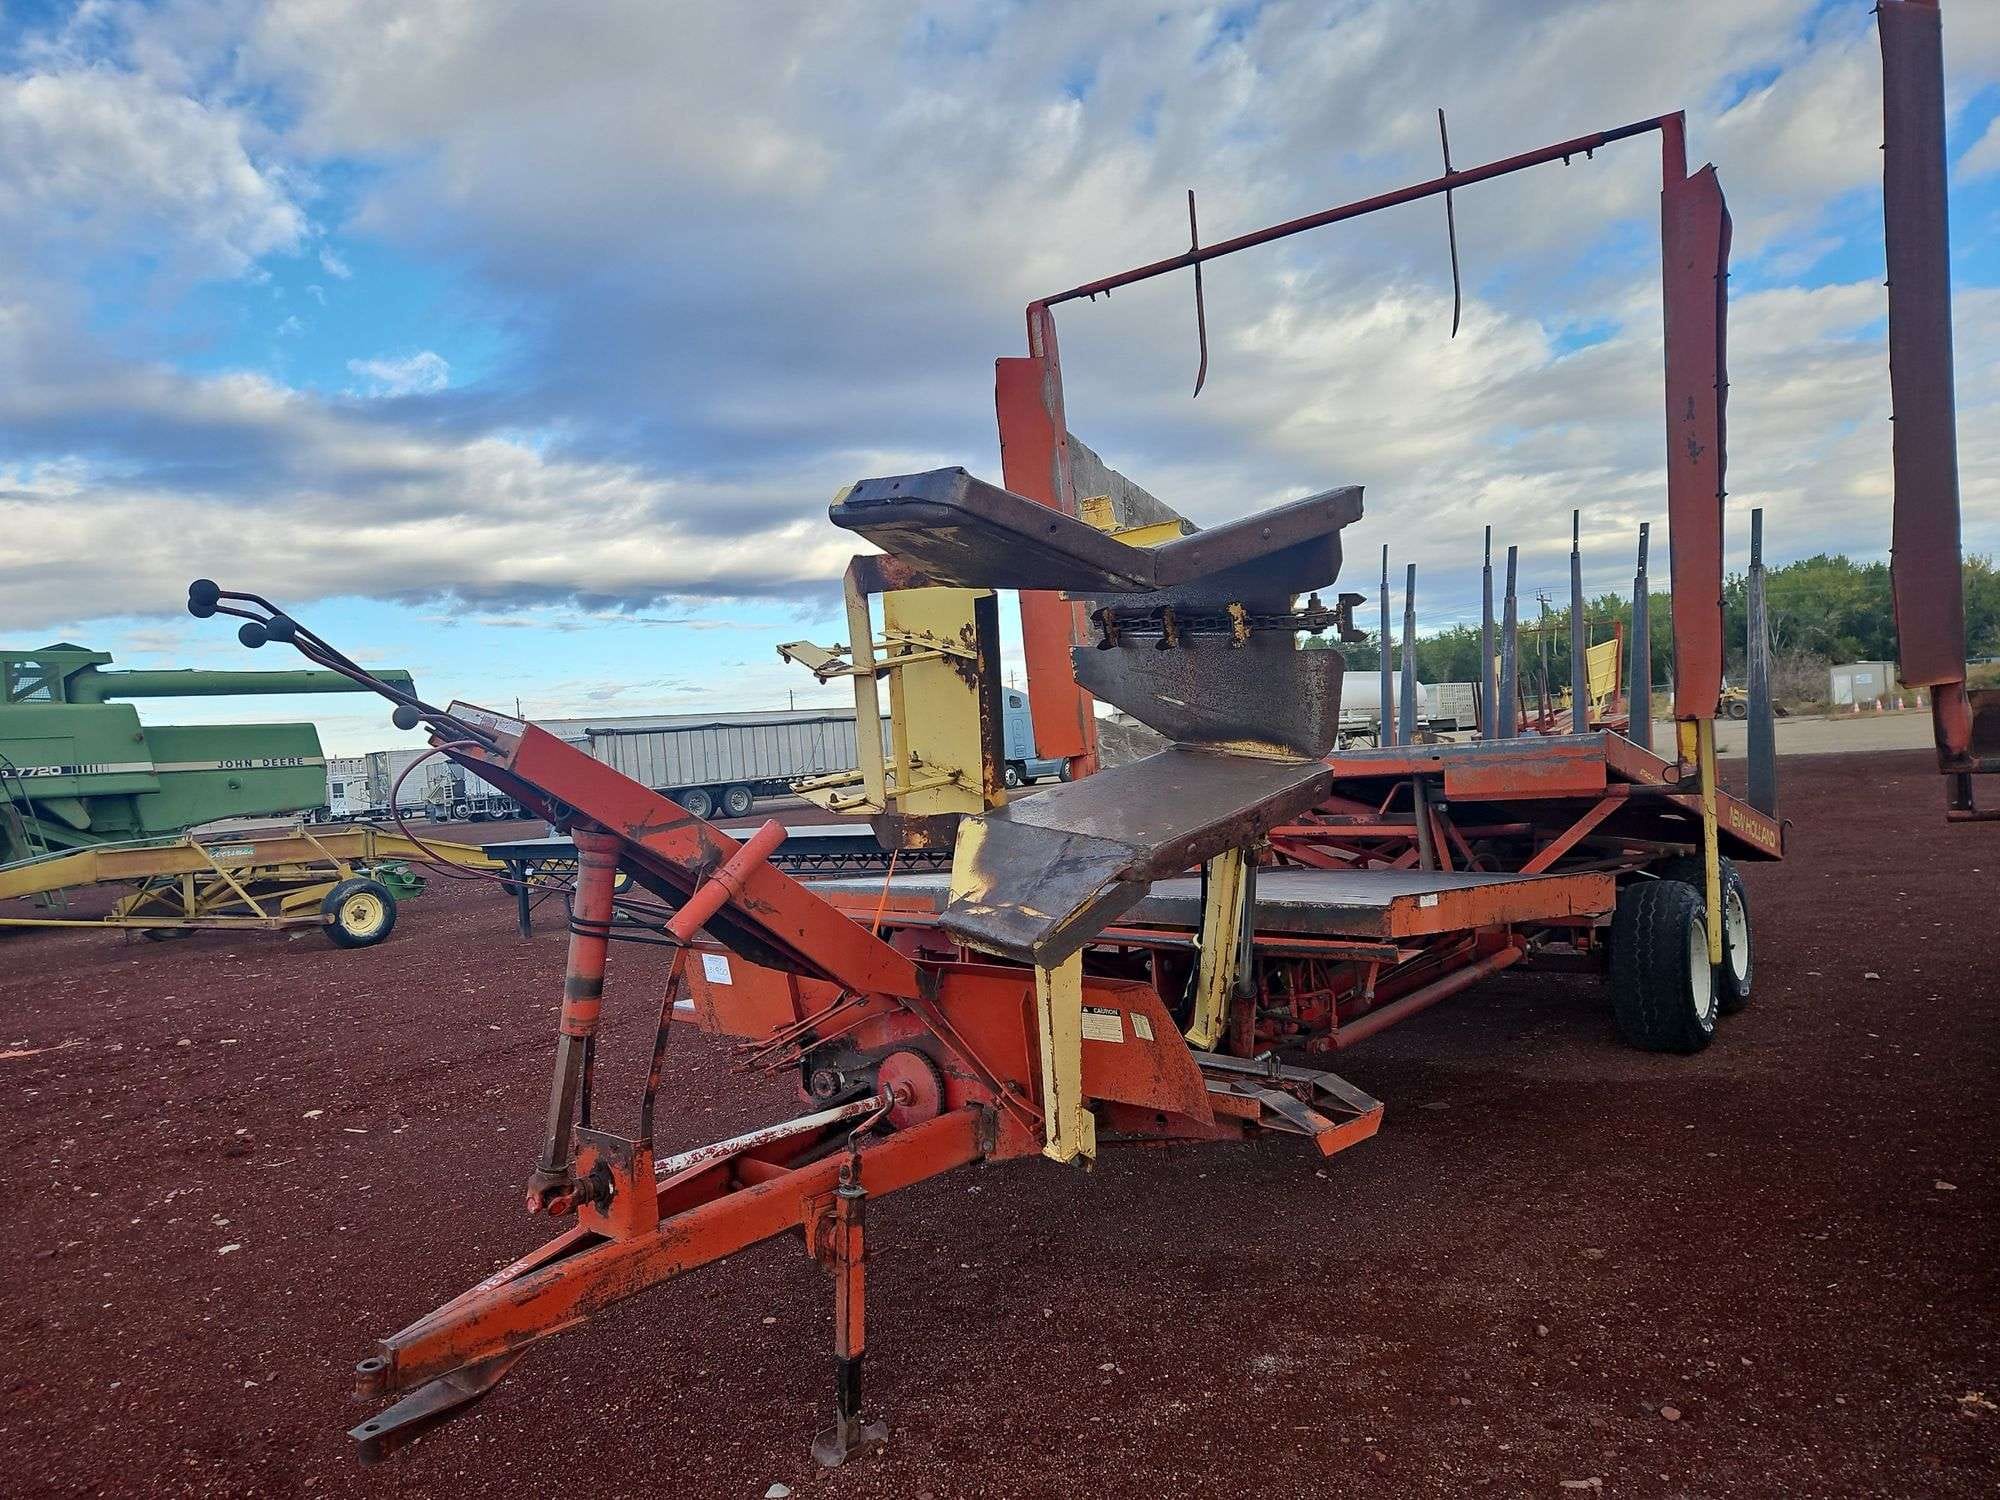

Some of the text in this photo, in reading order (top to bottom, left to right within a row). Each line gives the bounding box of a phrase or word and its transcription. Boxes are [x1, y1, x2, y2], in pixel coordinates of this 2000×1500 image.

[217, 757, 304, 769] JOHN DEERE
[15, 765, 62, 778] 7720
[1745, 816, 1776, 848] HOLLAND
[1093, 1007, 1118, 1015] CAUTION
